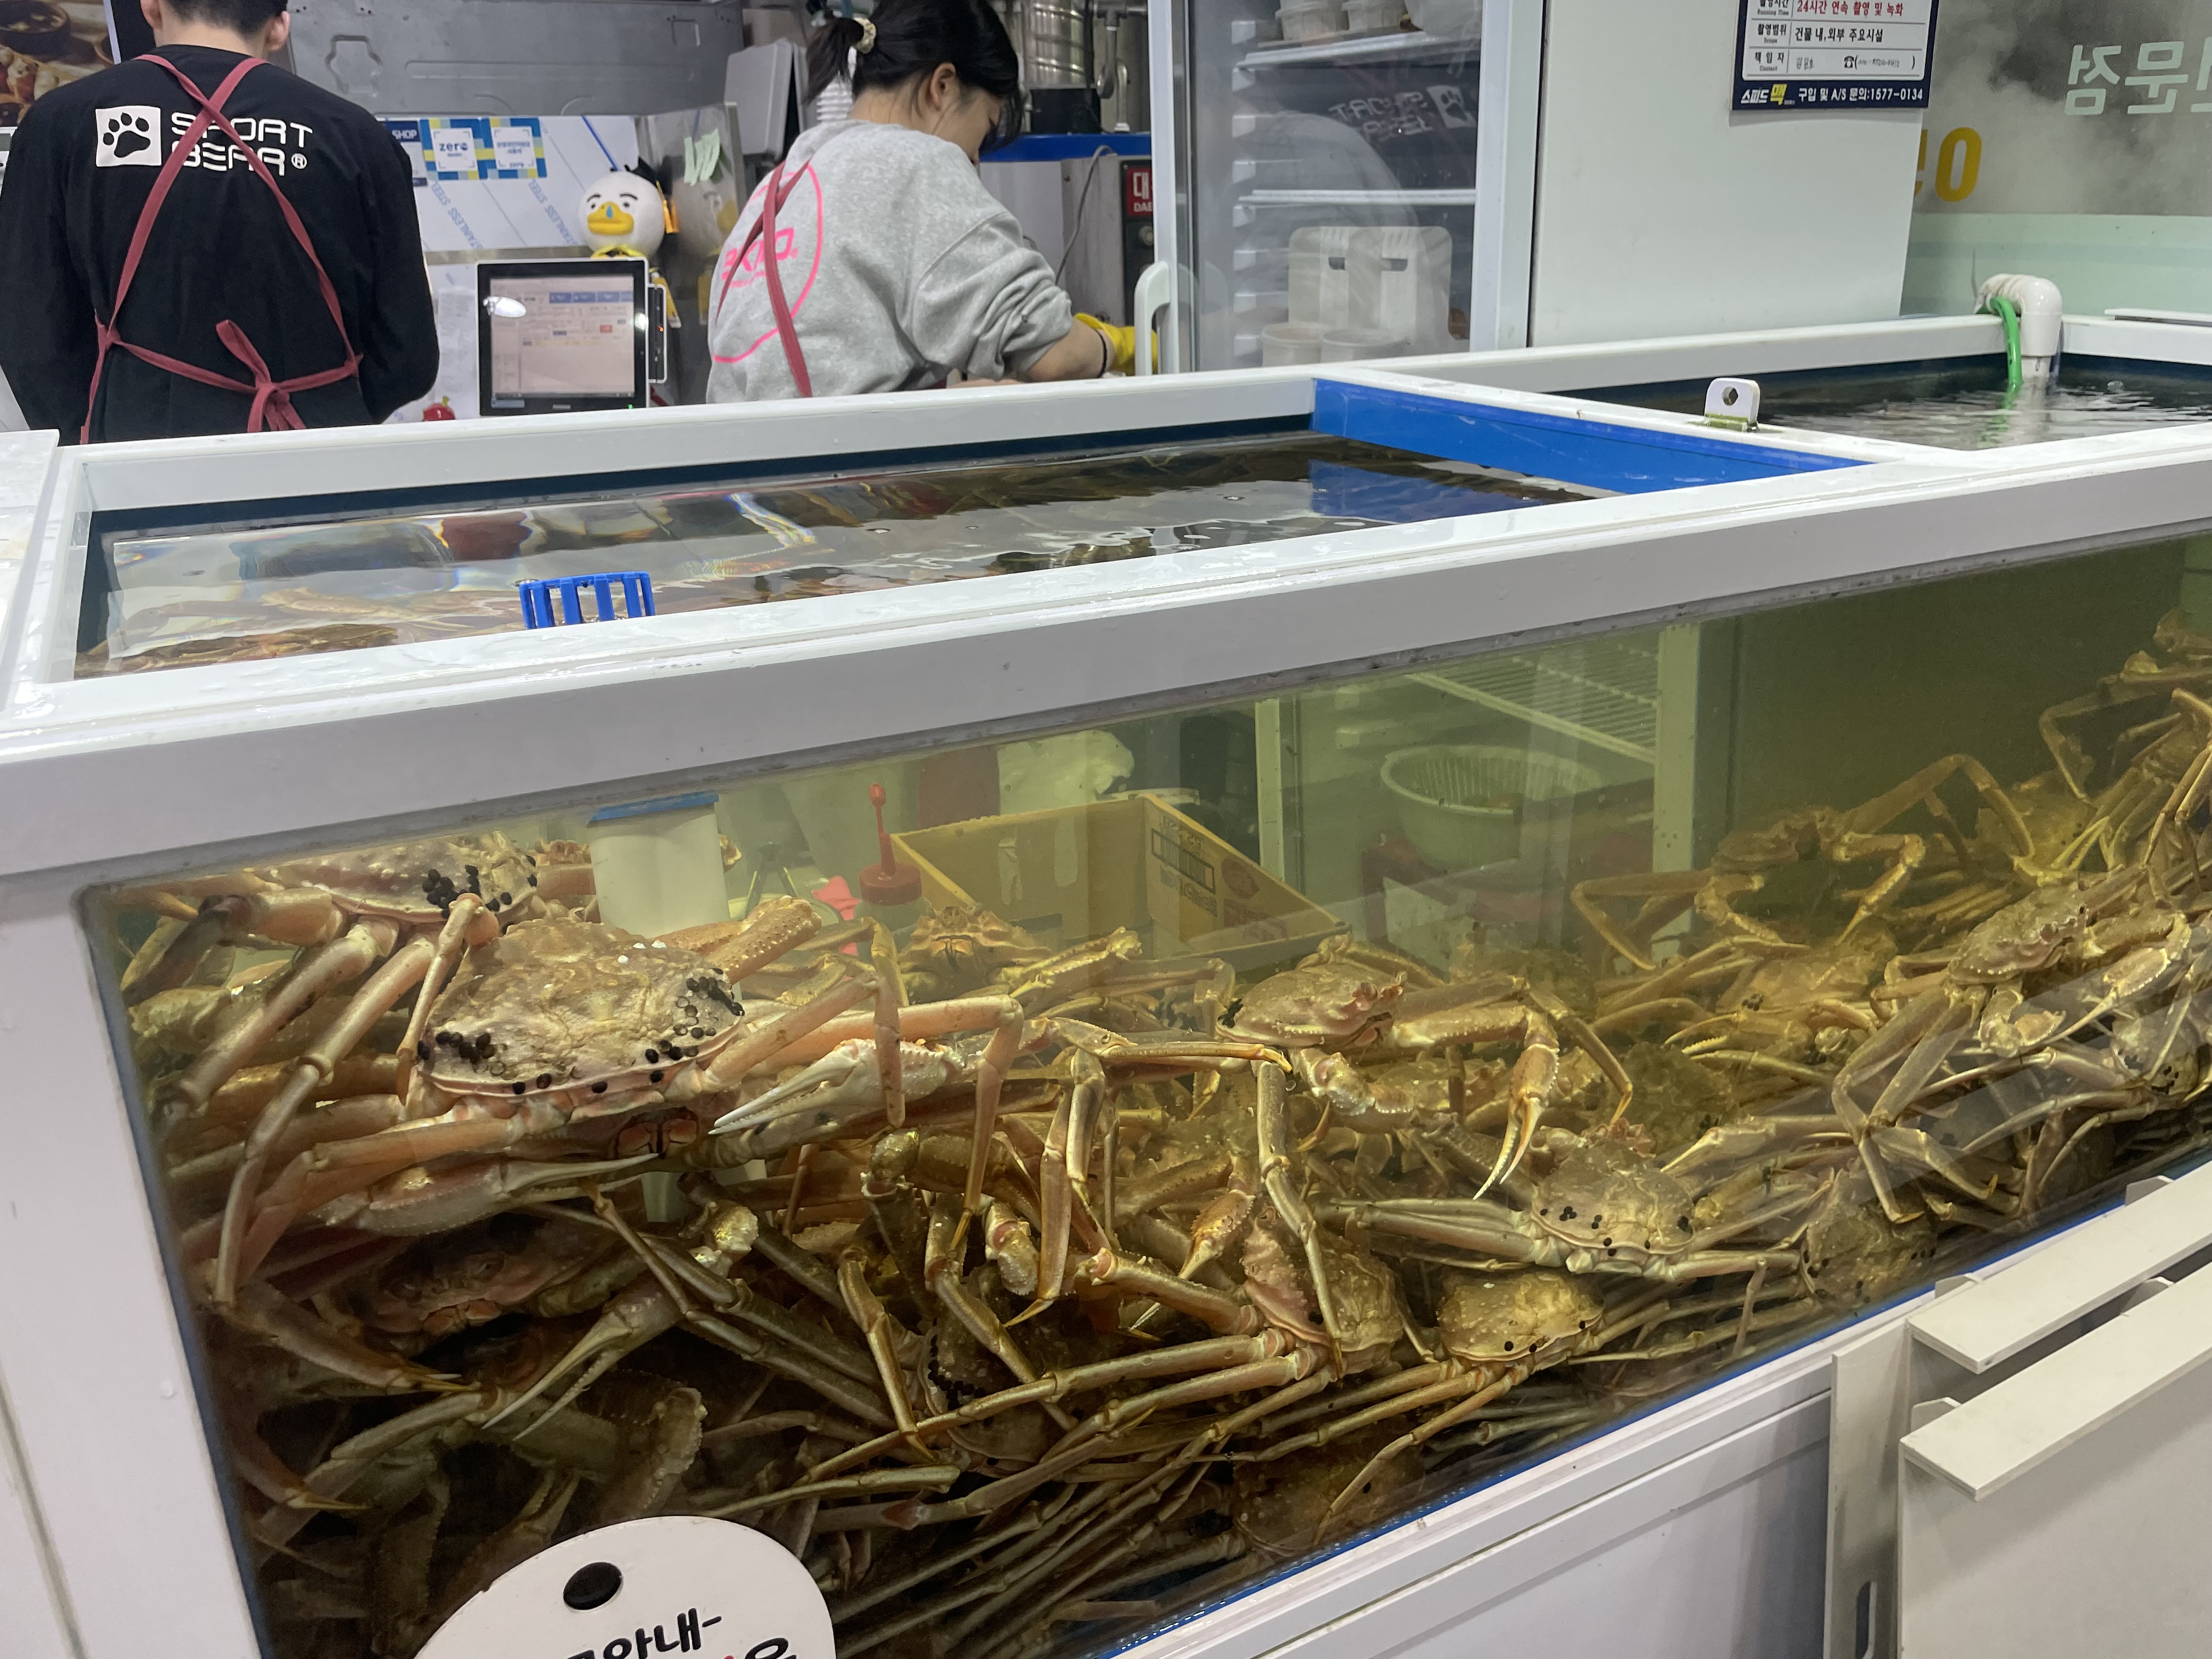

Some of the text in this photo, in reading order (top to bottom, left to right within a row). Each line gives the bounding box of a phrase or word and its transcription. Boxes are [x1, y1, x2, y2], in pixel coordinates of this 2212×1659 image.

[1797, 0, 1827, 14] 24시간
[1832, 1, 1848, 15] 연속
[1853, 1, 1870, 16] 촬영
[1875, 2, 1882, 16] 및
[1887, 2, 1903, 17] 녹화
[1795, 27, 1812, 42] 건물
[1849, 28, 1883, 43] 주요시설
[1798, 87, 1816, 103] 구입
[1820, 87, 1829, 101] 및
[1831, 88, 1847, 101] A/S
[392, 129, 417, 139] SHOP
[439, 142, 469, 152] zero
